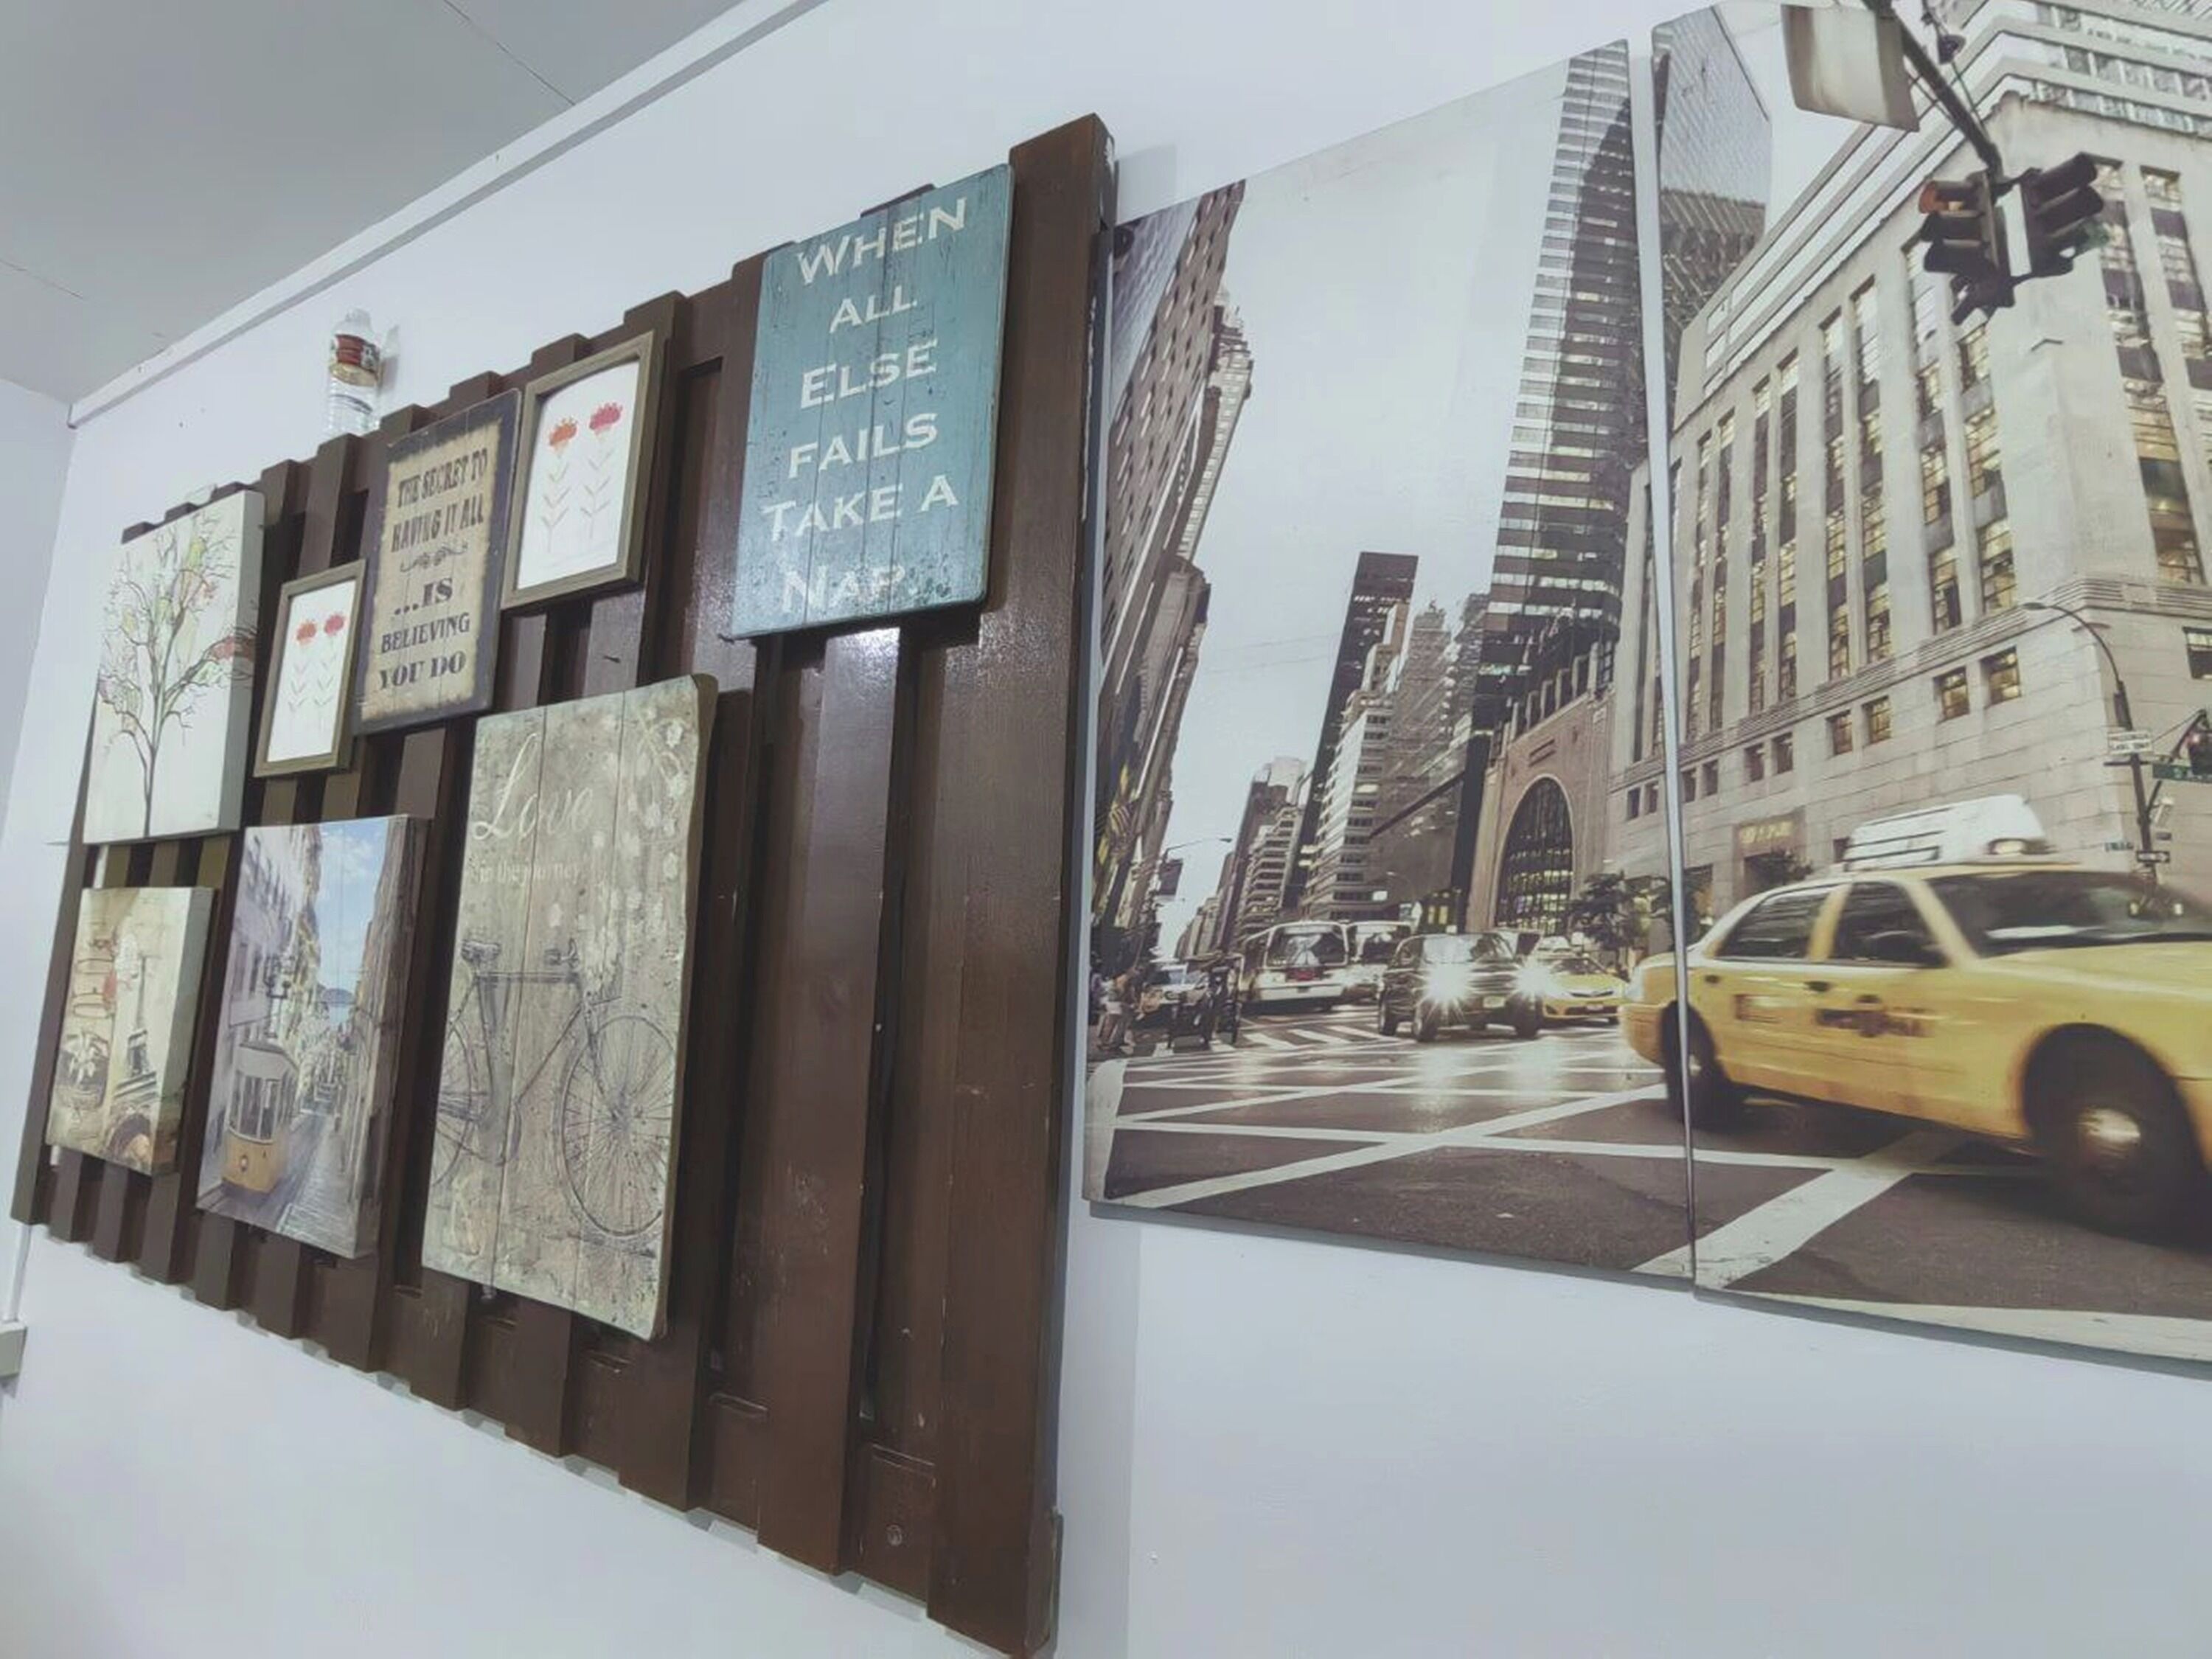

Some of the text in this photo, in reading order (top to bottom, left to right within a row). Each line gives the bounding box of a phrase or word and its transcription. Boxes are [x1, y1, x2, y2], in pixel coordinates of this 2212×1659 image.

[799, 198, 967, 285] WHEN
[829, 285, 917, 333] ALL
[800, 339, 937, 408] ELSE
[788, 413, 937, 478] FAILS
[397, 448, 487, 508] THE SECRET TO
[763, 475, 958, 541] TAKE A
[391, 493, 484, 552] HAVING IT ALL
[381, 612, 470, 653] BELIEVING
[380, 651, 466, 690] YOU DO
[473, 733, 592, 840] Love
